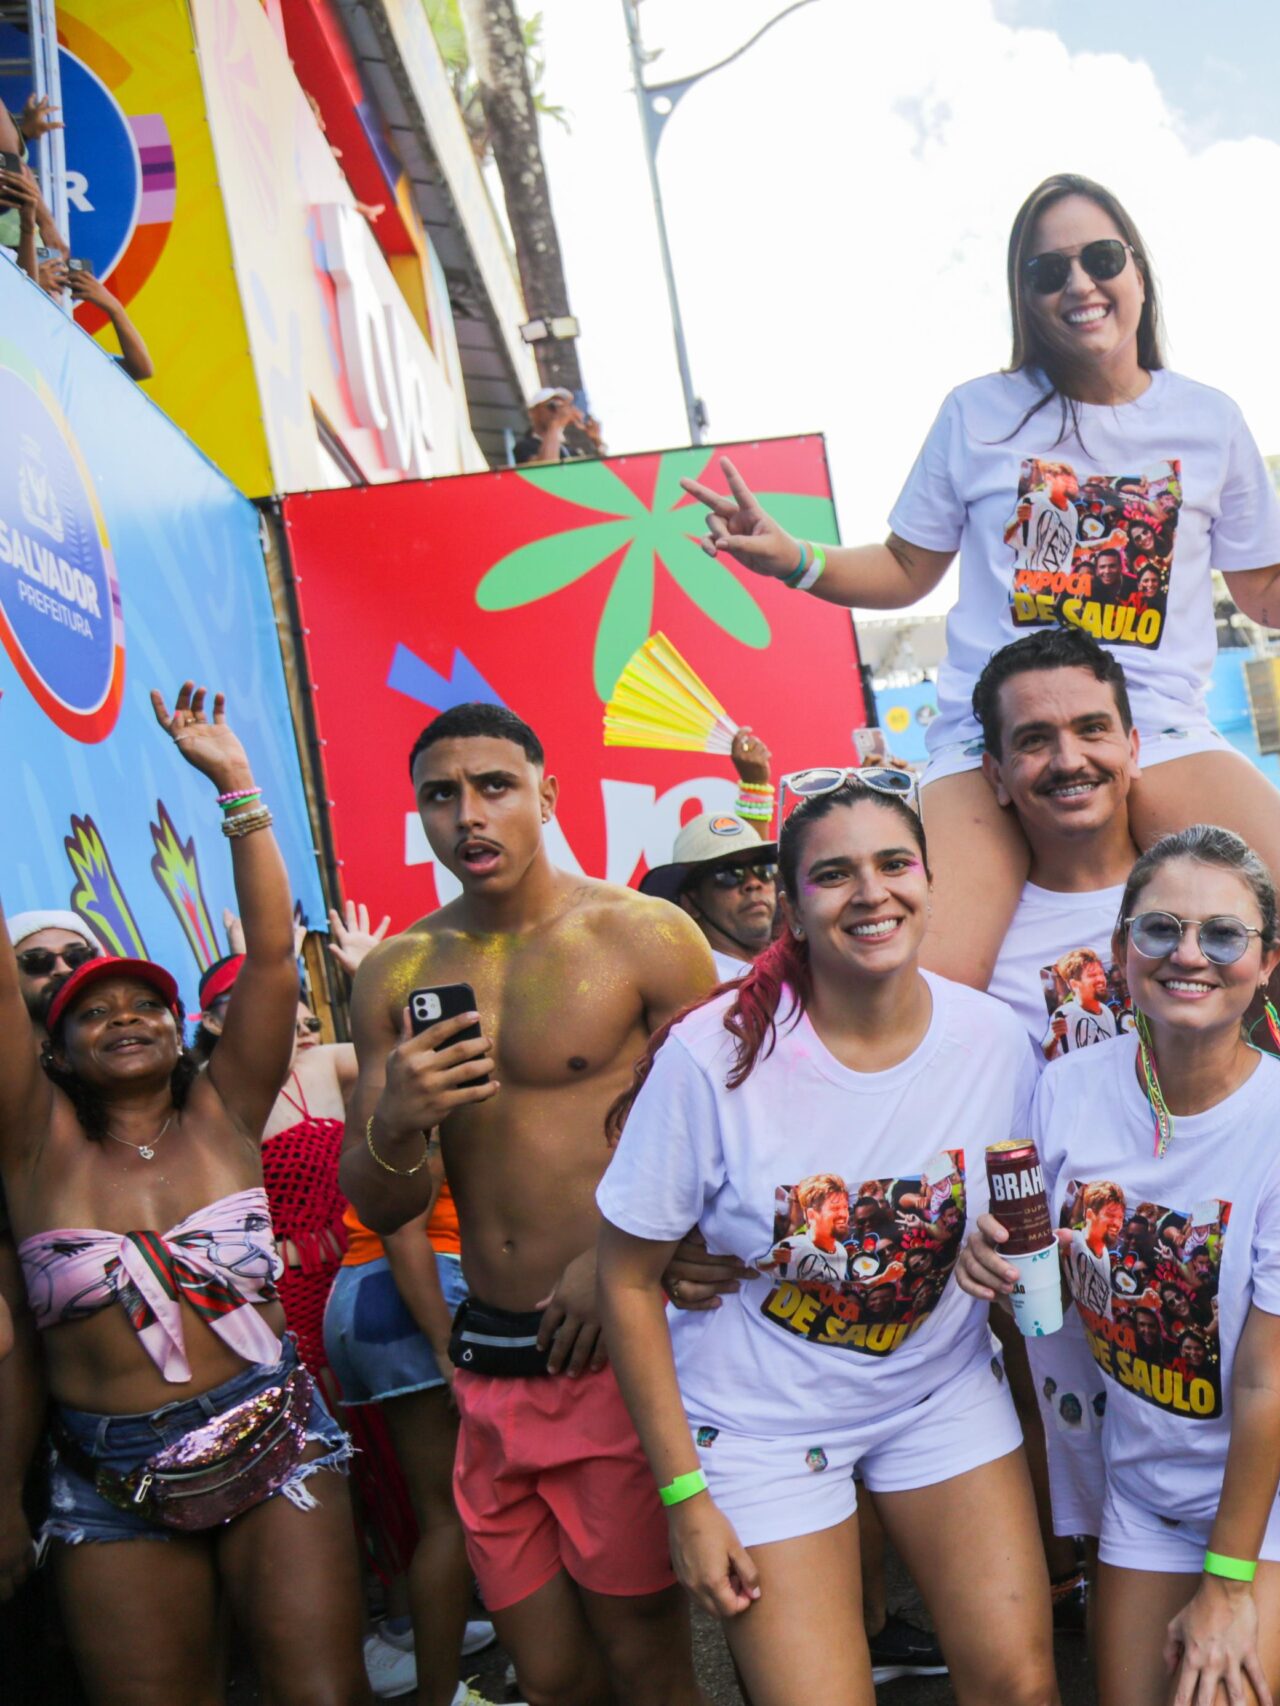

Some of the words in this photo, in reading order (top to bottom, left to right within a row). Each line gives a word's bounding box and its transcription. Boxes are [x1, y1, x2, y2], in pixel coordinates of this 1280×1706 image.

[18, 579, 94, 640] PREFEITURA
[1014, 592, 1057, 621] DE
[1062, 598, 1161, 644] SAULO
[768, 1281, 821, 1335] DE
[1116, 1351, 1215, 1415] SAULO
